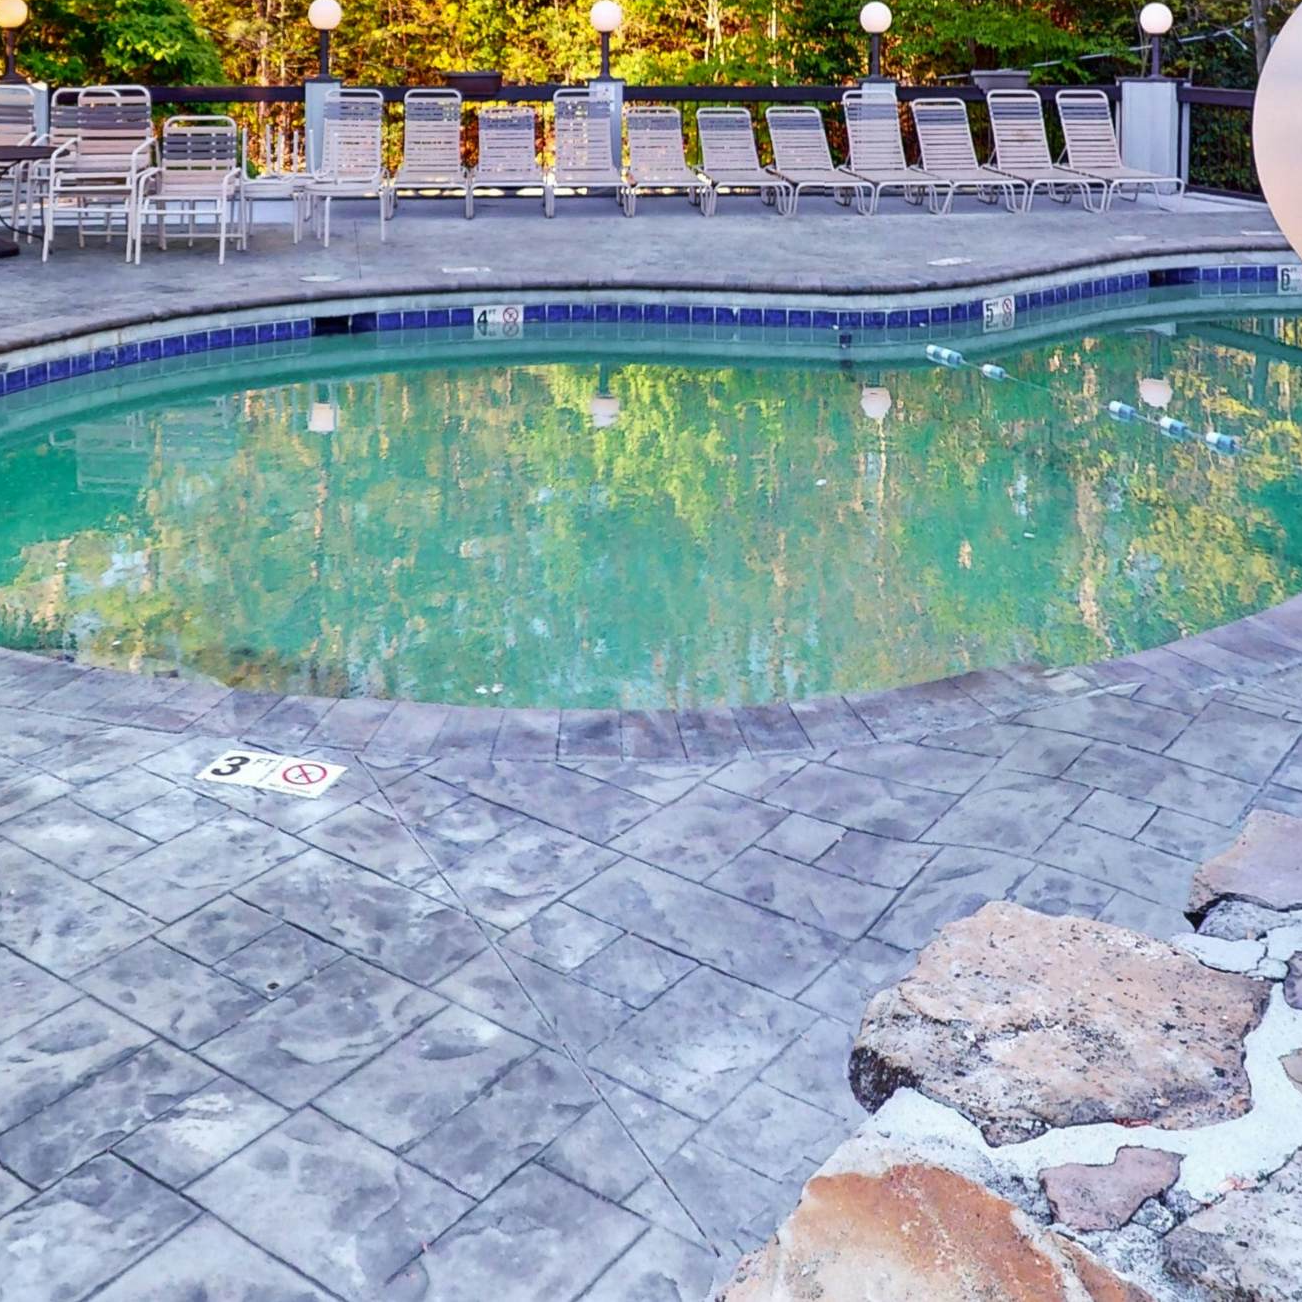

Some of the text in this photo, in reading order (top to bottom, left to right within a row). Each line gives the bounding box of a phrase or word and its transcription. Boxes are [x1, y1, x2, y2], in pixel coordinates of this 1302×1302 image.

[477, 309, 488, 324] 4
[210, 755, 277, 777] 3 FT
